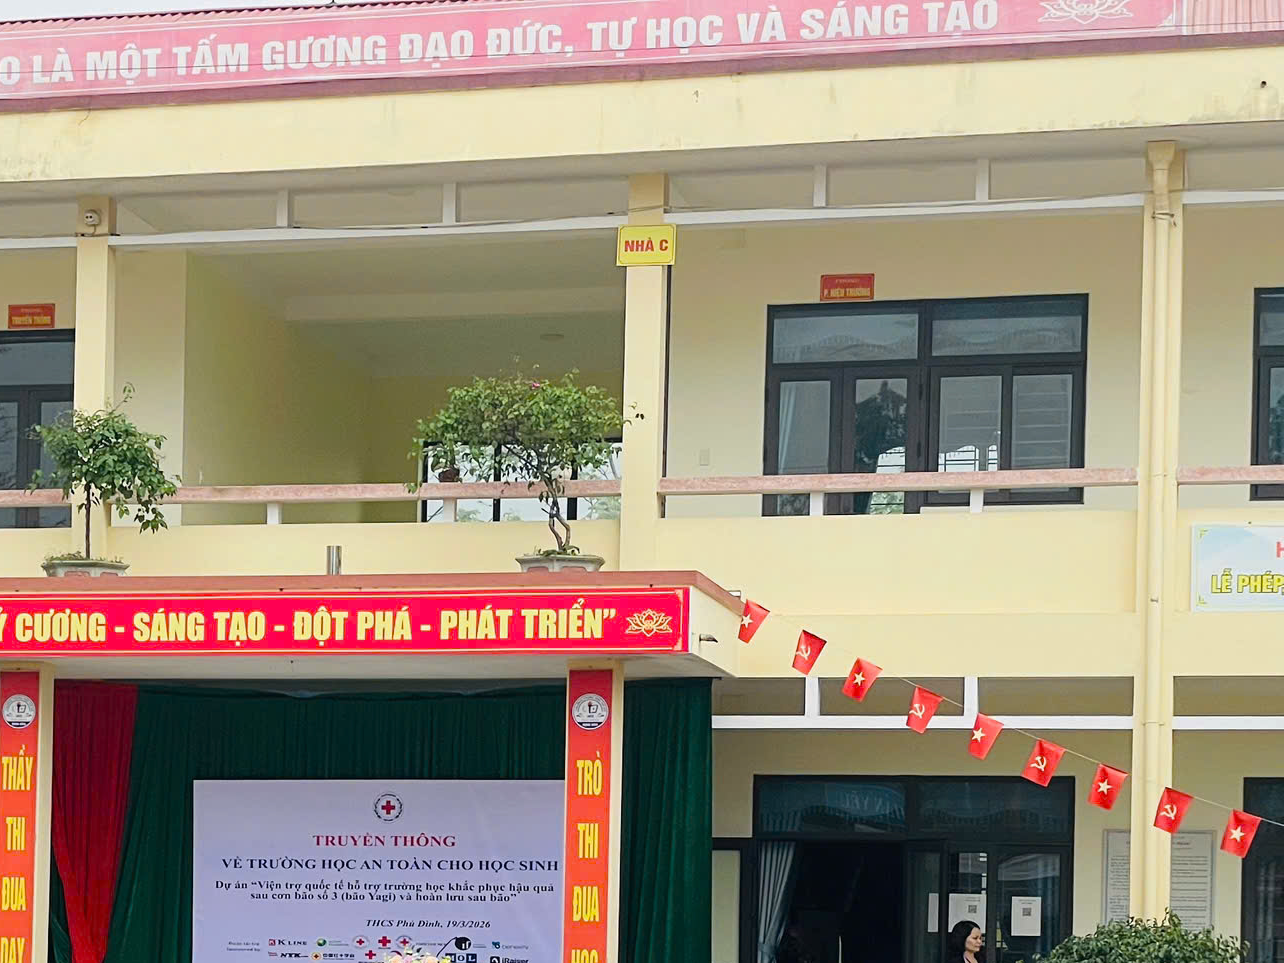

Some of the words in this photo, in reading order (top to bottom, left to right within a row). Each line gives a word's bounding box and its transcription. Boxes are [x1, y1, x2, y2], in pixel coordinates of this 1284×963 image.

[32, 47, 74, 84] LÀ
[86, 43, 161, 85] MỘT
[172, 34, 249, 75] TẤM
[262, 35, 386, 70] GƯƠNG
[398, 30, 474, 68] ĐẠO
[486, 20, 574, 58] ĐỨC,
[587, 17, 638, 57] TỰ
[646, 15, 723, 54] HỌC
[737, 5, 786, 44] VÀ
[799, 1, 909, 40] SÁNG
[923, 0, 998, 38] TẠO
[624, 237, 654, 252] NHÀ
[659, 239, 669, 252] C
[15, 608, 106, 643] CƯƠNG
[133, 607, 205, 643] SÁNG
[213, 611, 266, 647] TẠO
[293, 606, 348, 647] ĐỘT
[357, 606, 412, 641] PHÁ
[440, 604, 513, 640] PHÁT
[576, 751, 603, 796] TRÒ
[5, 816, 26, 851] THI
[390, 832, 456, 847] THÔNG
[577, 823, 599, 859] THI
[247, 856, 316, 870] TRƯỜNG
[321, 859, 357, 872] HỌC
[360, 859, 382, 870] AN
[387, 857, 432, 871] TOÀN
[437, 859, 474, 871] CHO
[479, 860, 515, 873] HỌC
[519, 860, 559, 871] SINH
[1, 877, 27, 912] ĐUA
[234, 881, 248, 890] án
[285, 881, 302, 892] trợ
[305, 879, 331, 892] quốc
[384, 881, 423, 893] trường
[425, 882, 445, 892] học
[448, 880, 475, 892] khắc
[478, 882, 505, 893] phục
[509, 882, 530, 894] hậu
[250, 892, 268, 900] sau
[271, 892, 291, 901] cơn
[294, 891, 315, 901] bão
[317, 889, 329, 901] số
[331, 892, 338, 901] 3
[369, 892, 396, 903] Yagi)
[399, 893, 412, 901] và
[415, 893, 443, 902] hoàn
[446, 893, 465, 902] lưu
[467, 894, 486, 902] sau
[572, 885, 600, 922] ĐUA
[366, 919, 394, 928] THCS
[446, 919, 491, 928] 19/3/2026
